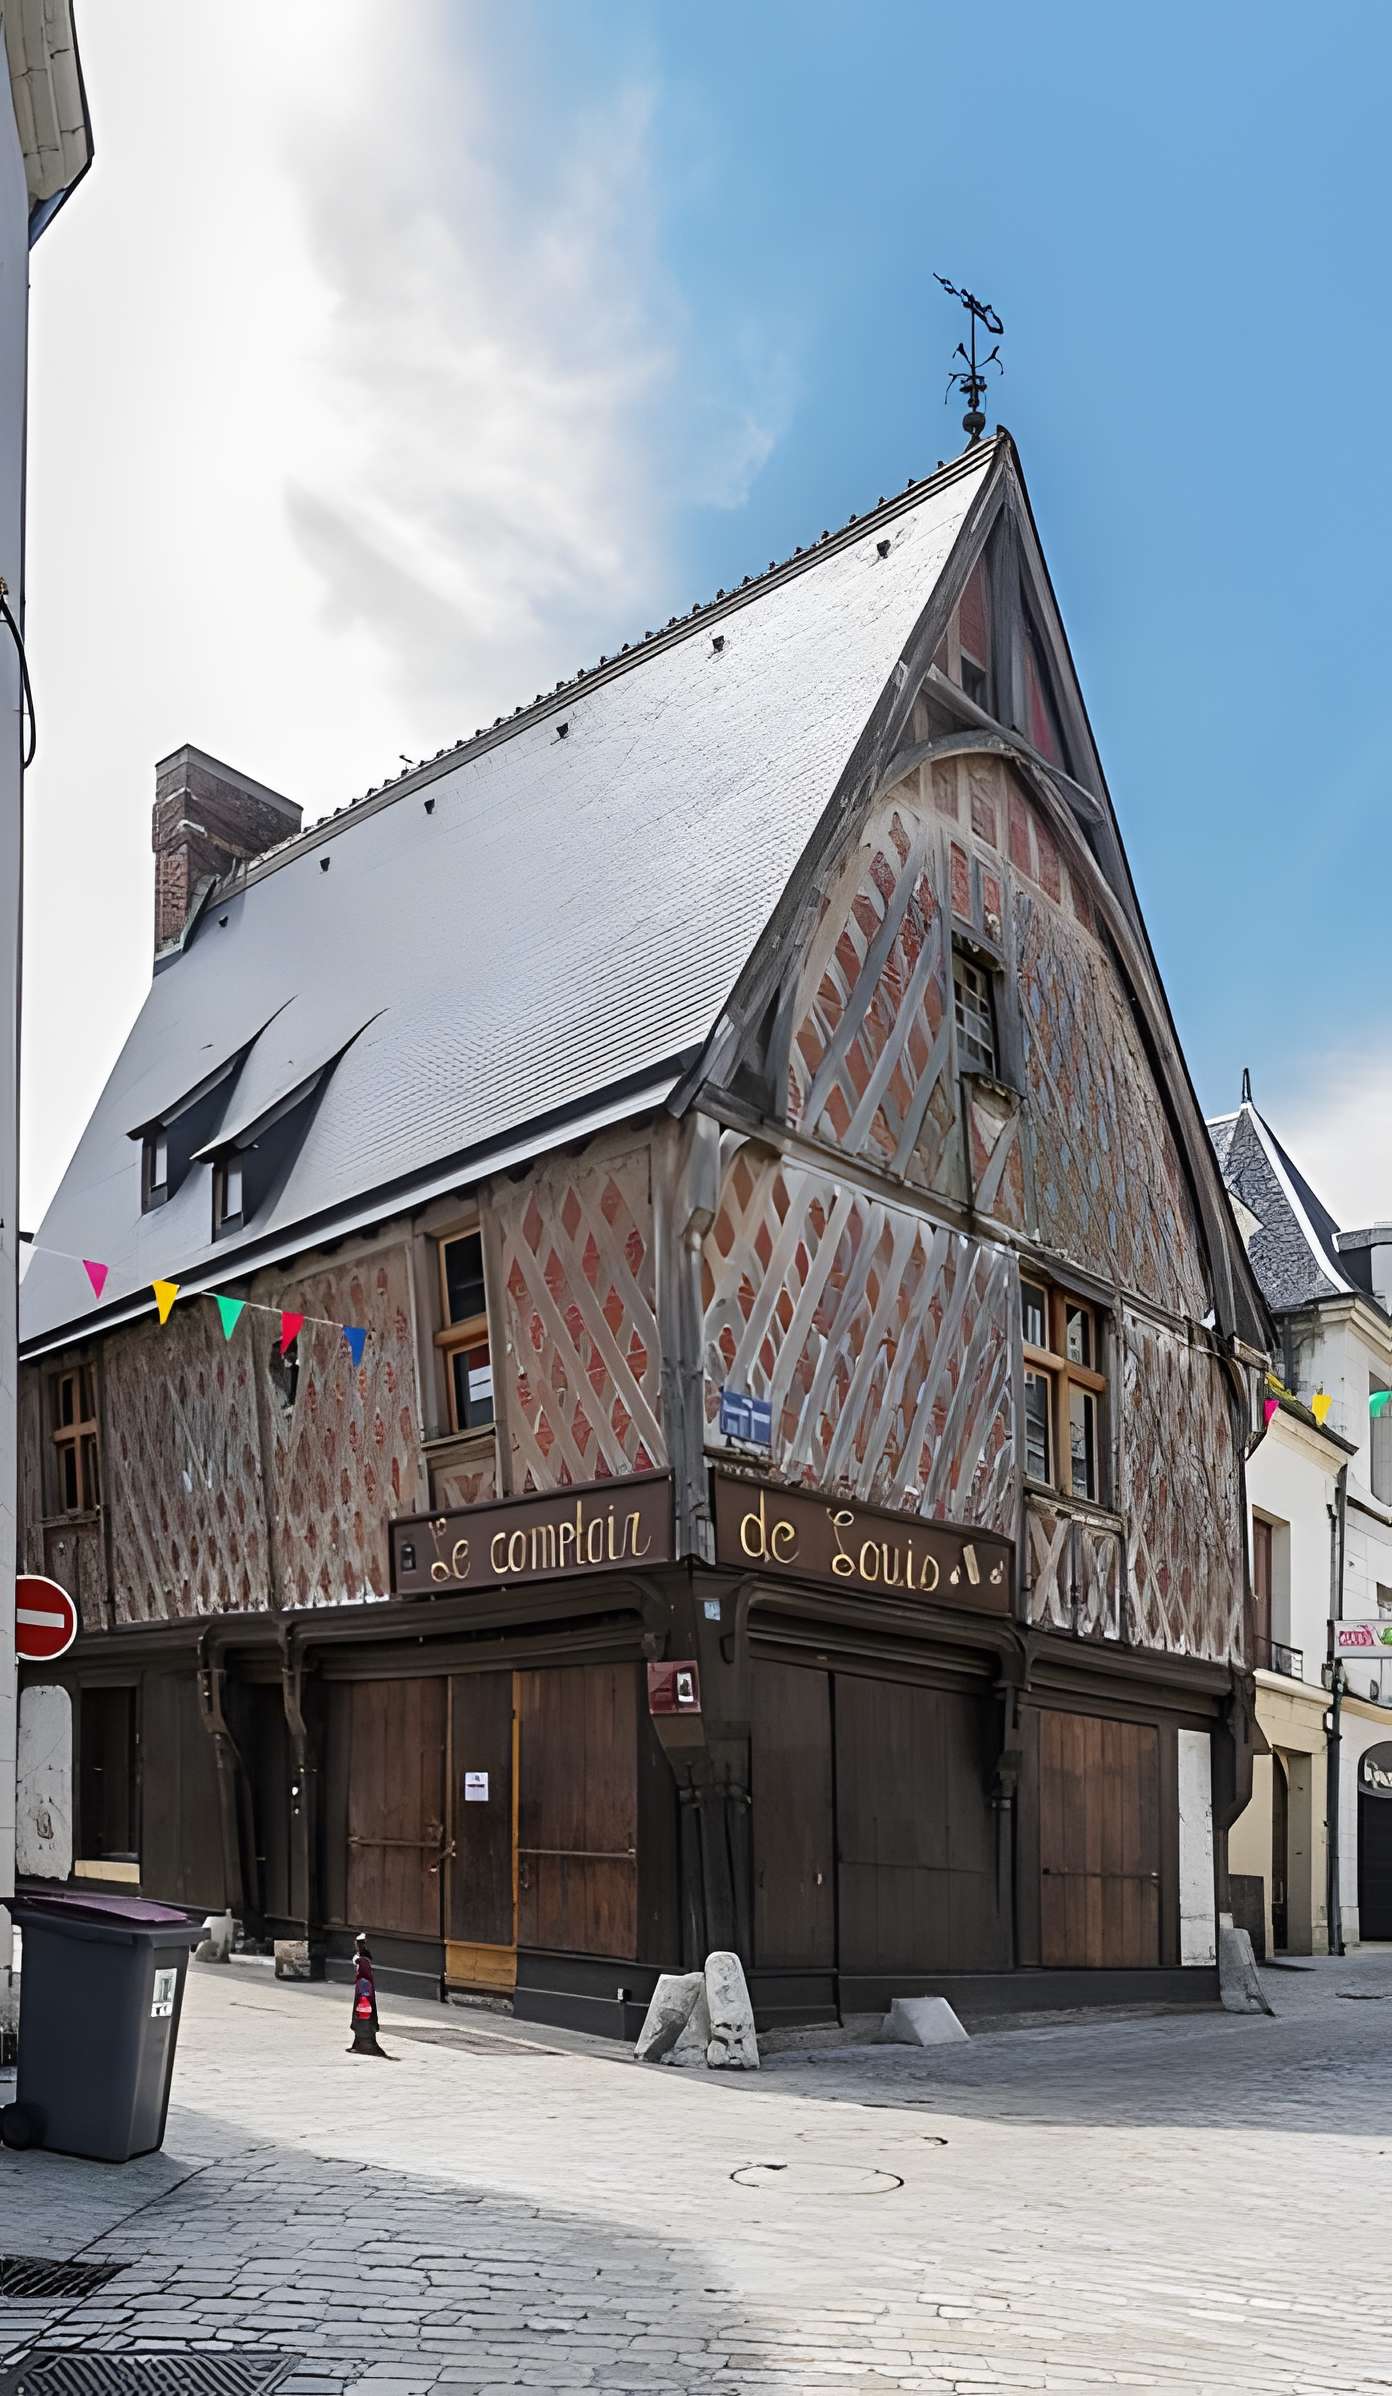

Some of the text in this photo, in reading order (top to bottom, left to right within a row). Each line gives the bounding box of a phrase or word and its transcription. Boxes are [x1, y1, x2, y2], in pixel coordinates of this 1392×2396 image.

[428, 1517, 471, 1582] Le
[740, 1488, 800, 1563] de
[826, 1506, 939, 1592] Louis
